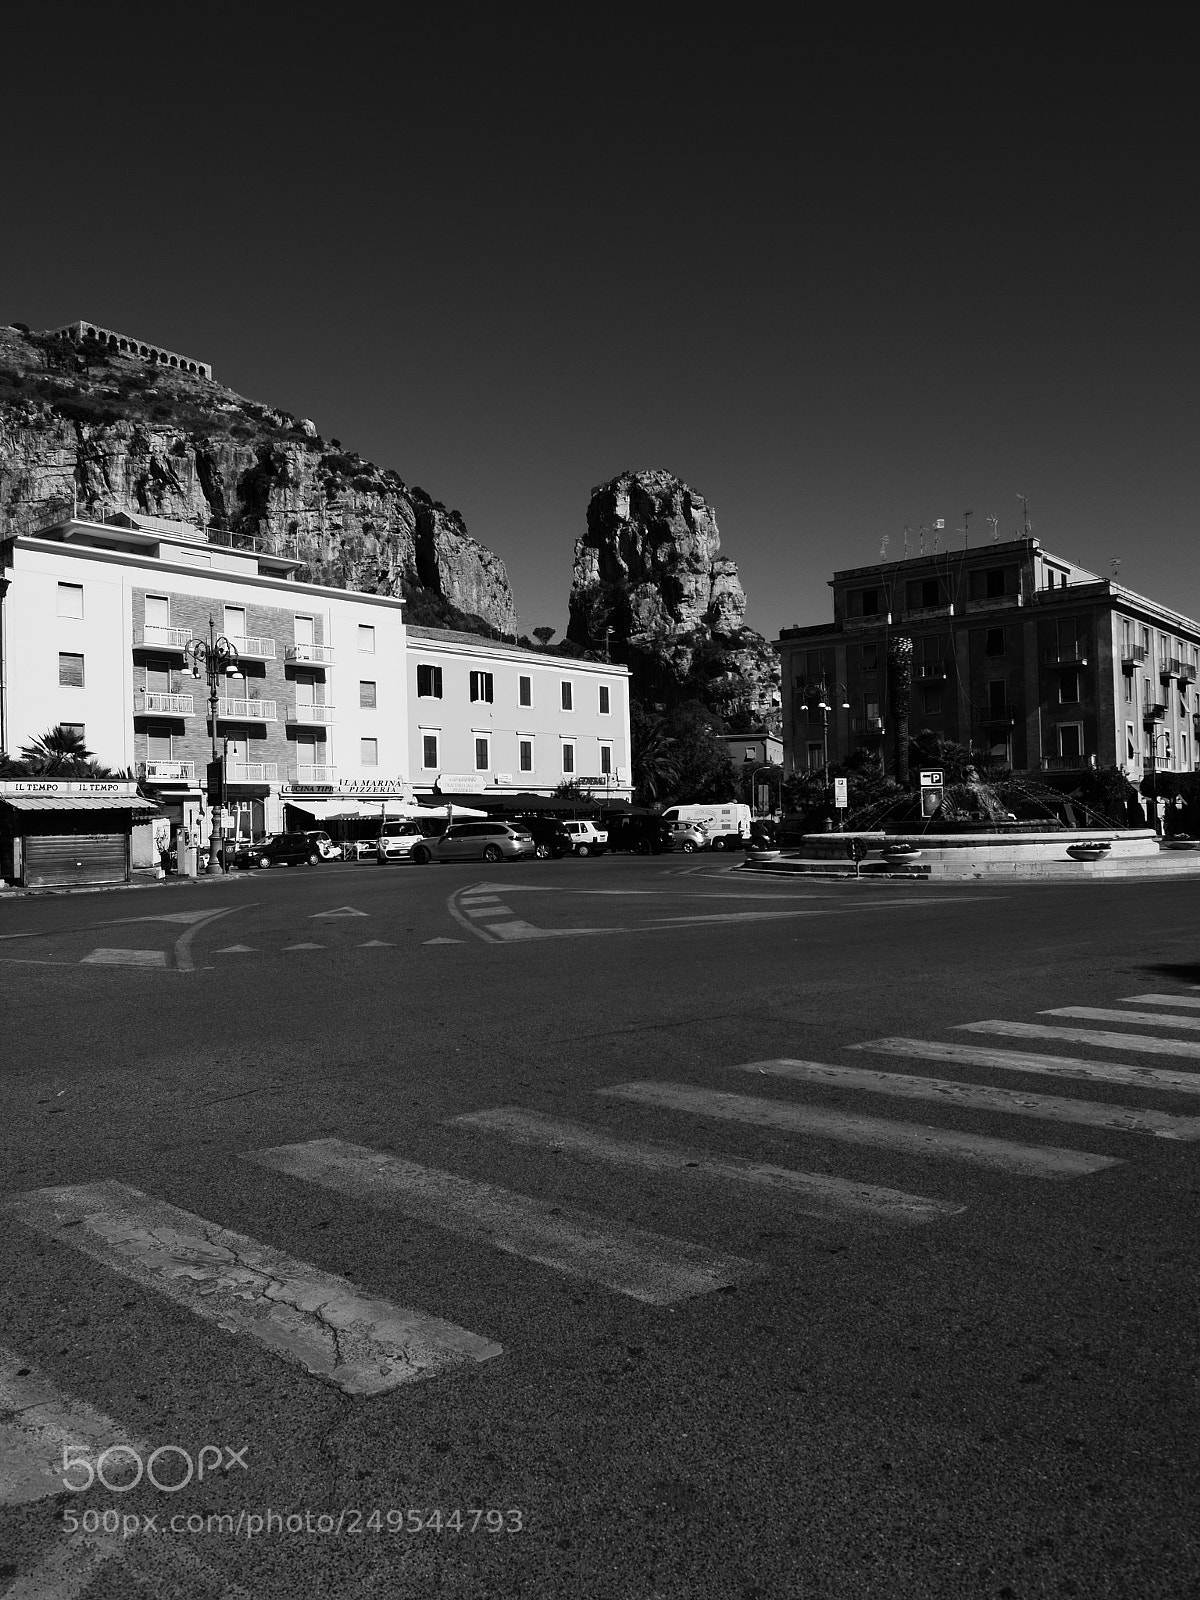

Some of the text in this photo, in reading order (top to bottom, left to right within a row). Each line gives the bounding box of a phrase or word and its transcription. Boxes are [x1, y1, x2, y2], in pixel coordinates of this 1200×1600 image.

[933, 774, 940, 783] P
[15, 783, 59, 791] IL TEMPO
[345, 779, 401, 787] LA MARINA
